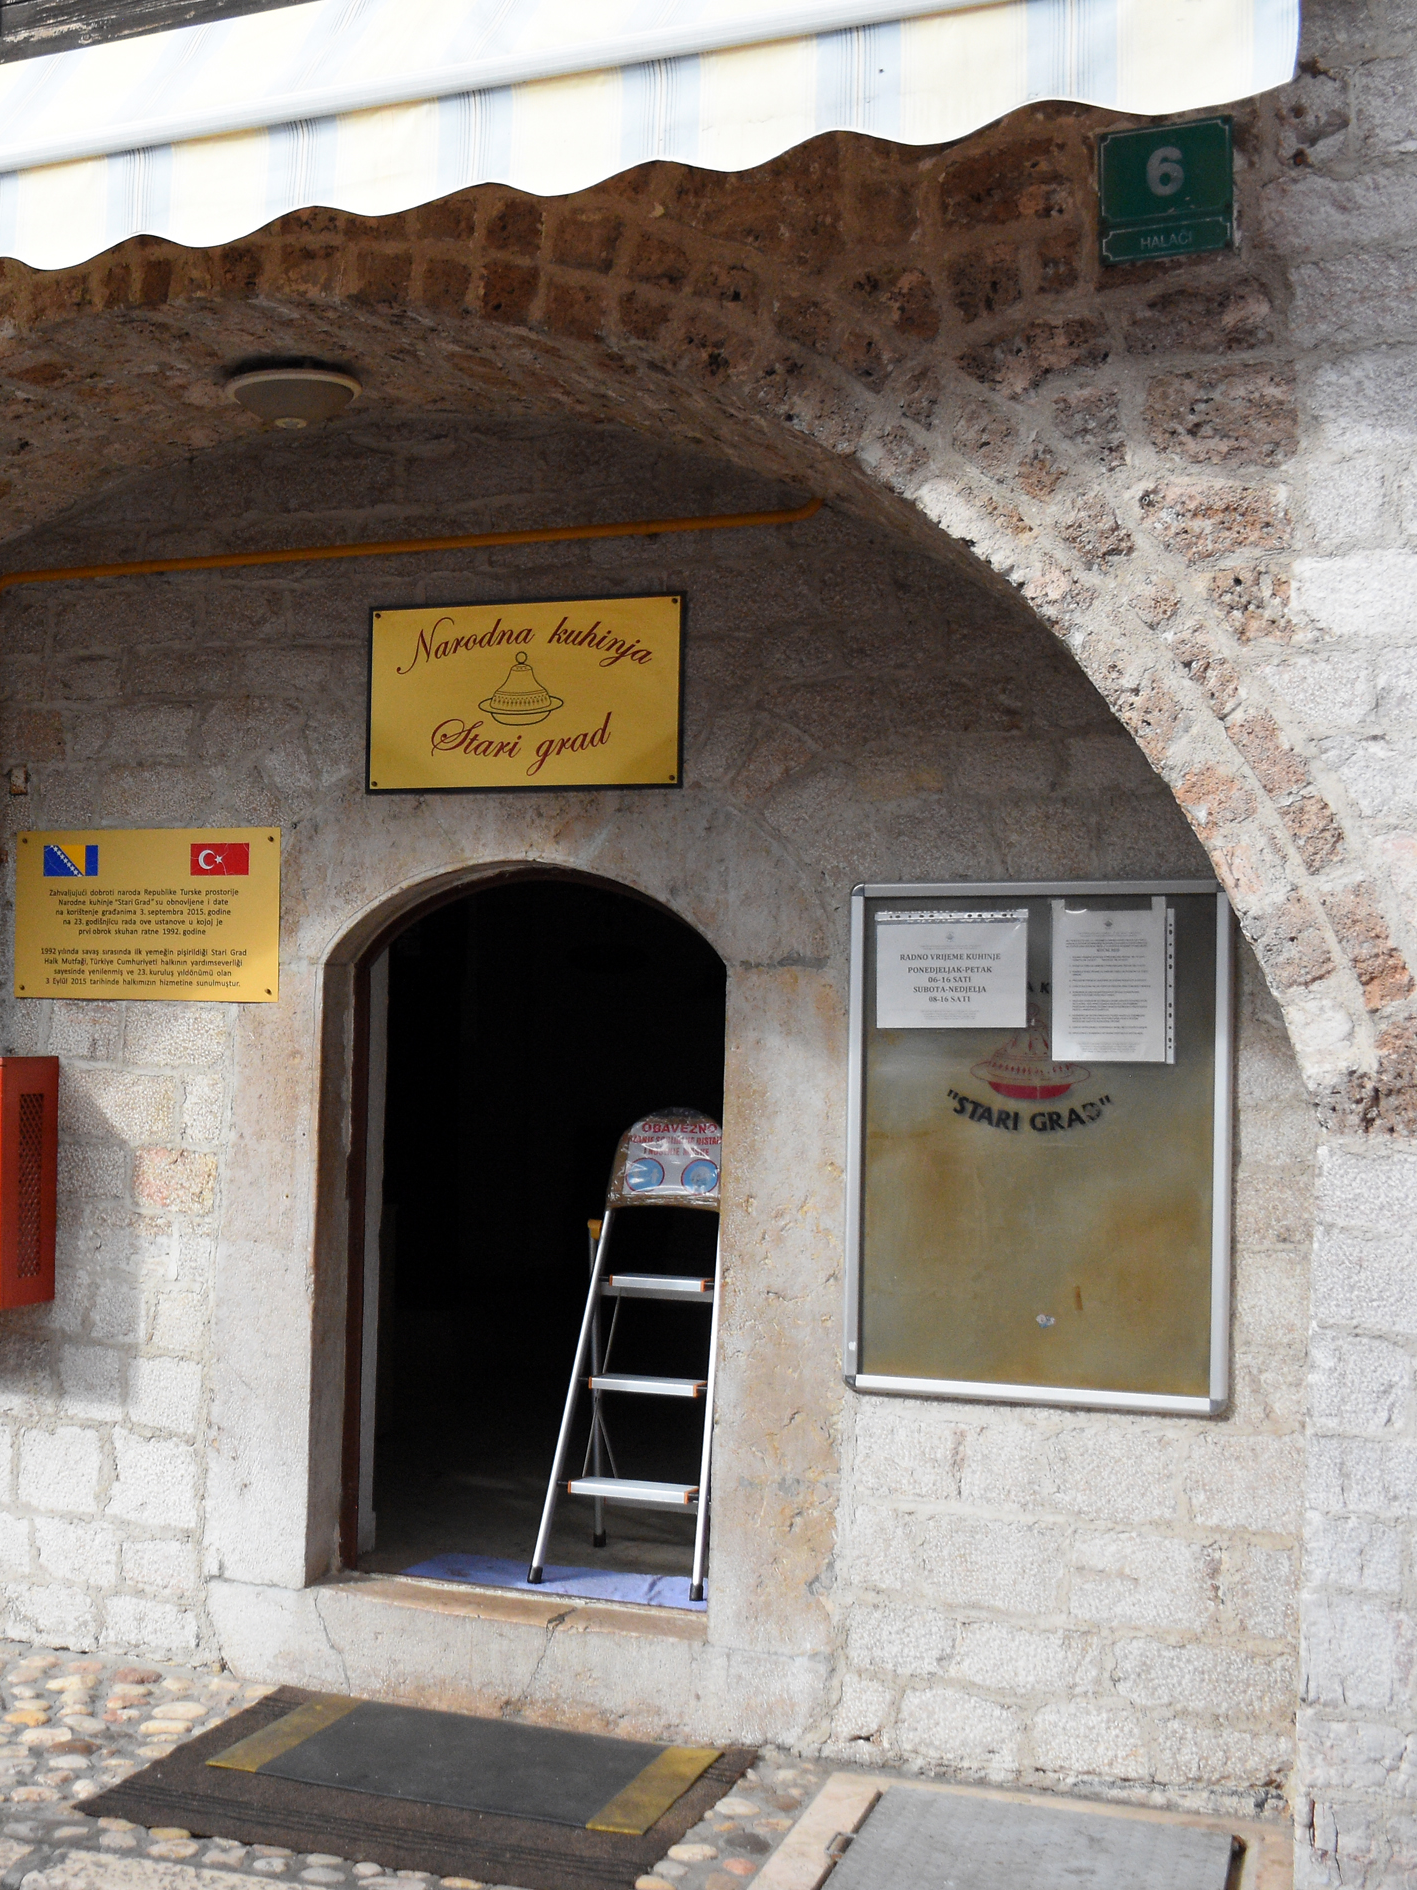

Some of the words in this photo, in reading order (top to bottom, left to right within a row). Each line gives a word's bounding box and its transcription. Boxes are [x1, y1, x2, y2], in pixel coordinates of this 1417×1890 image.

[1147, 146, 1185, 197] 6
[396, 617, 535, 675] Narodna
[547, 617, 653, 668] kuhinja
[431, 718, 521, 757] Stari
[526, 711, 612, 776] grad
[144, 889, 177, 897] Republike
[205, 889, 238, 897] prostorije
[89, 899, 113, 907] kuhinje
[166, 898, 204, 907] obnovljene
[207, 898, 210, 906] i
[213, 898, 228, 906] date
[66, 908, 98, 916] korištenje
[102, 908, 136, 916] građanima
[148, 908, 184, 916] septembra
[187, 908, 206, 916] 2015.
[208, 908, 231, 916] godine
[86, 918, 118, 926] godišnjicu
[78, 928, 91, 936] prvi
[183, 928, 206, 936] godine
[966, 953, 1001, 961] KUHINJE
[90, 958, 113, 966] Türkiye
[116, 958, 157, 966] Cumhuriyeti
[88, 968, 123, 976] yenilenmiş
[149, 969, 174, 977] kuruluş
[908, 966, 992, 974] PONEDJELJAK-PETAK
[53, 978, 67, 986] Eylül
[642, 1122, 718, 1134] OBAVEZNO
